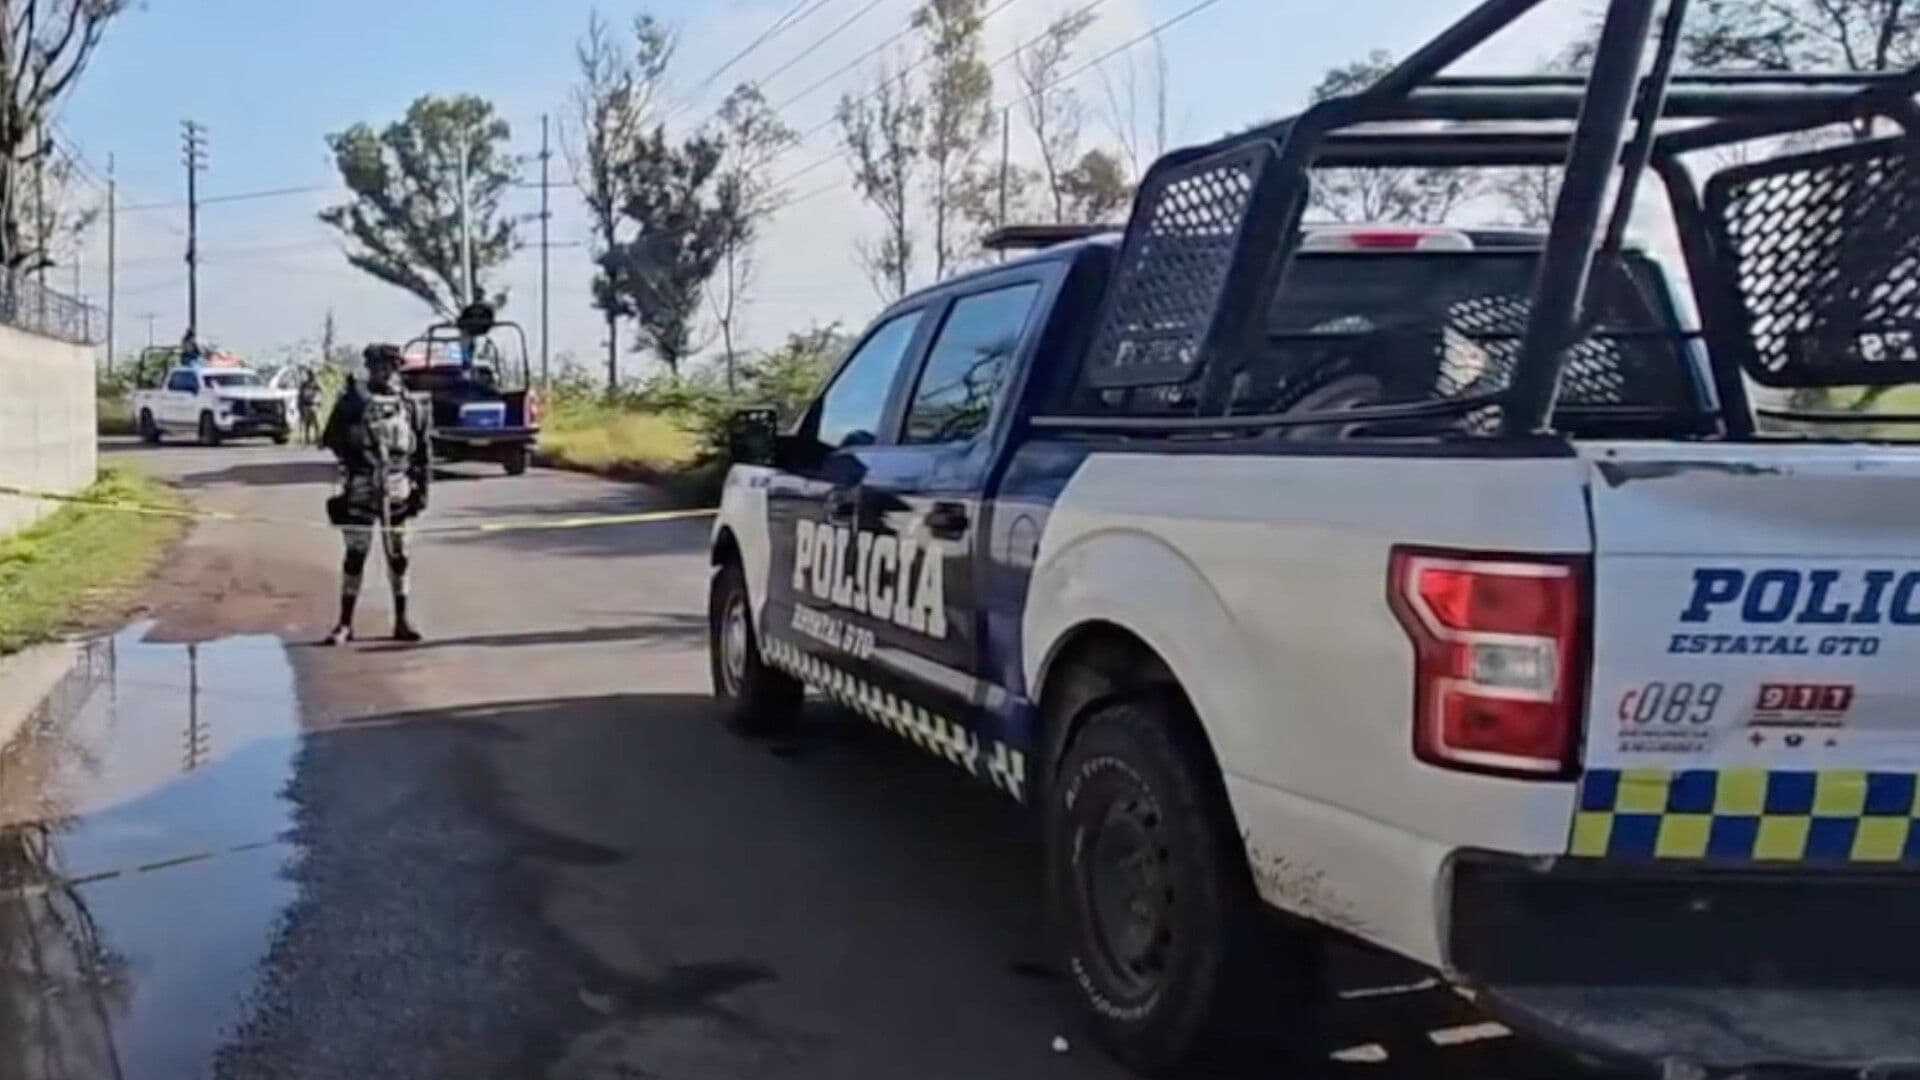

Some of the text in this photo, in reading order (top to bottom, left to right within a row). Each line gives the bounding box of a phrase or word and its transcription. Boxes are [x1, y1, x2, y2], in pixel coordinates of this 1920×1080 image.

[1667, 634, 1881, 656] ESTATAL GTO
[1633, 682, 1723, 723] 089
[1761, 687, 1845, 709] 911
